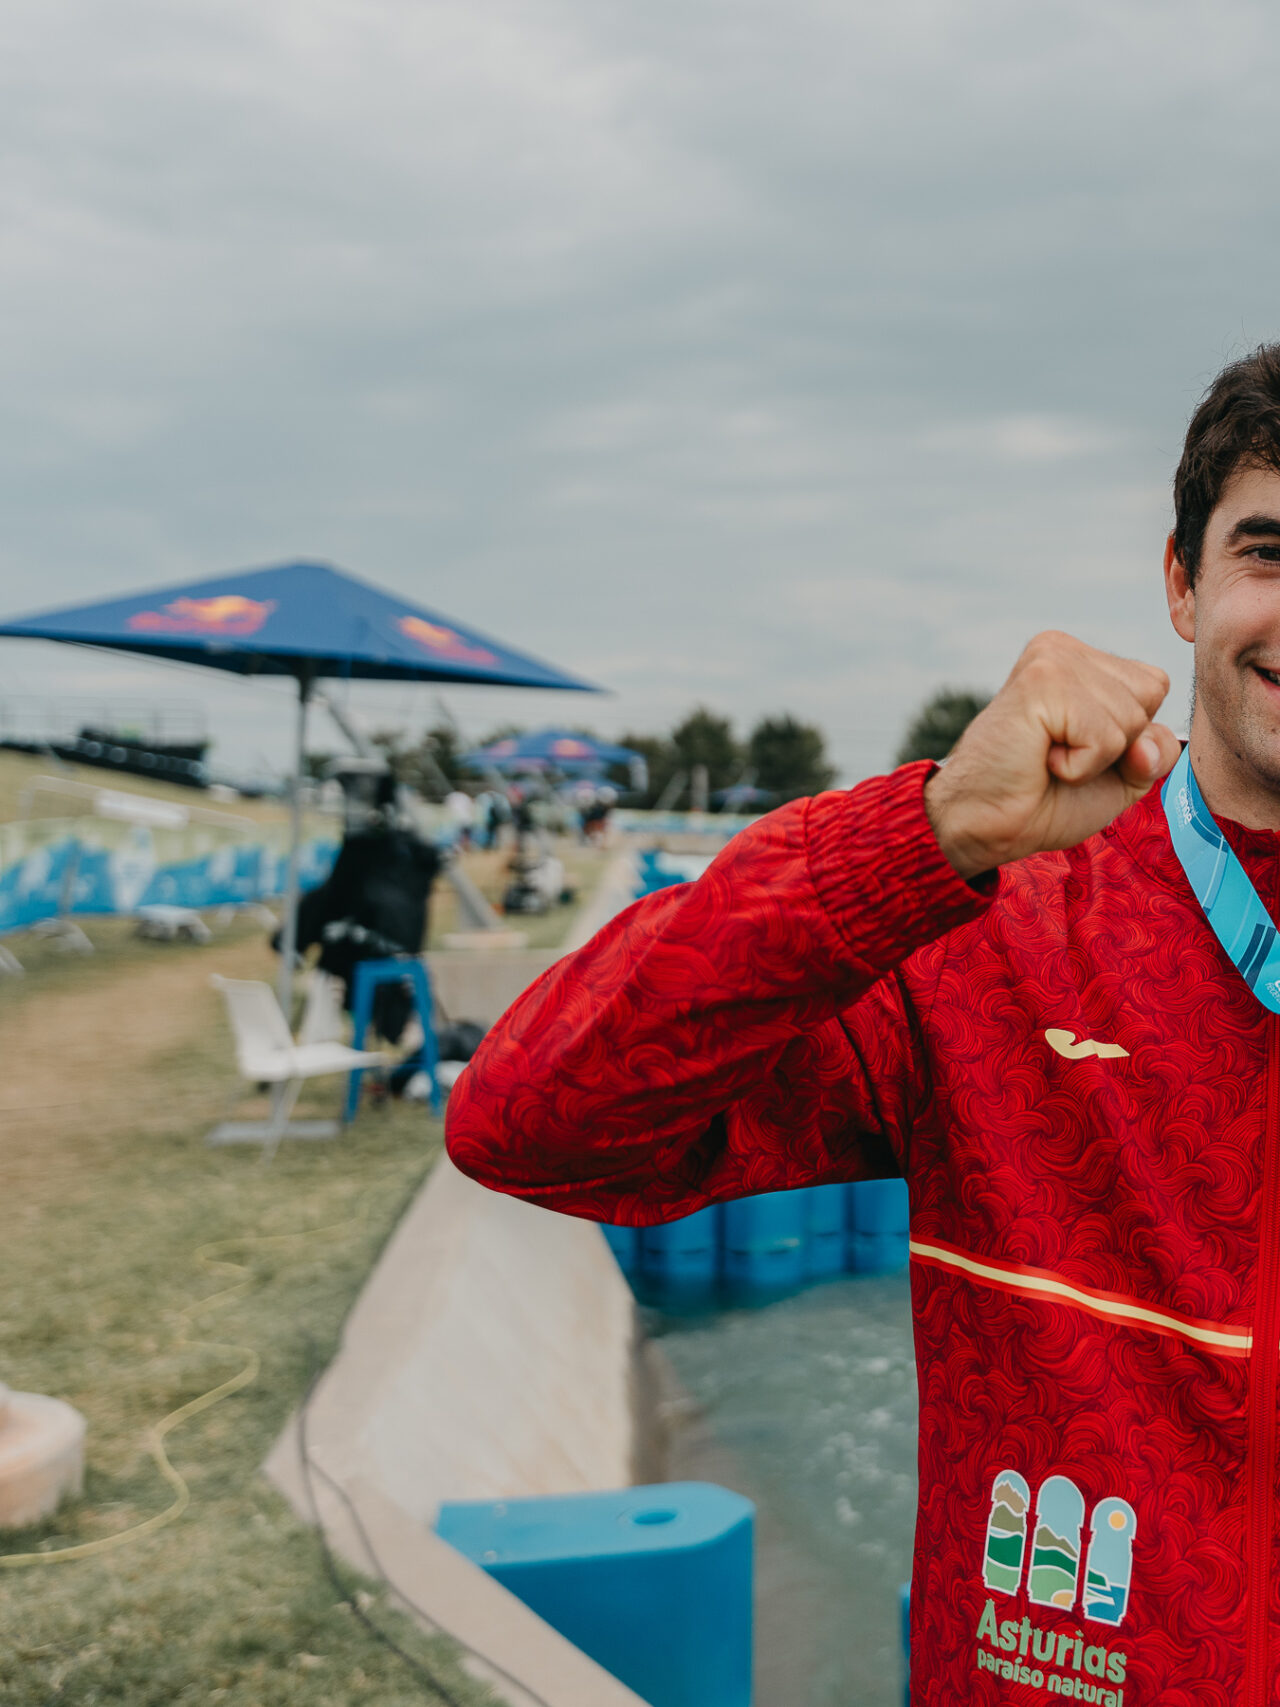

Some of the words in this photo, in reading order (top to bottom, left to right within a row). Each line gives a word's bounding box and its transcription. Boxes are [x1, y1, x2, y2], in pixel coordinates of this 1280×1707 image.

[976, 1598, 1127, 1684] Asturias
[977, 1648, 1044, 1688] paraíso
[1047, 1674, 1124, 1707] natural
